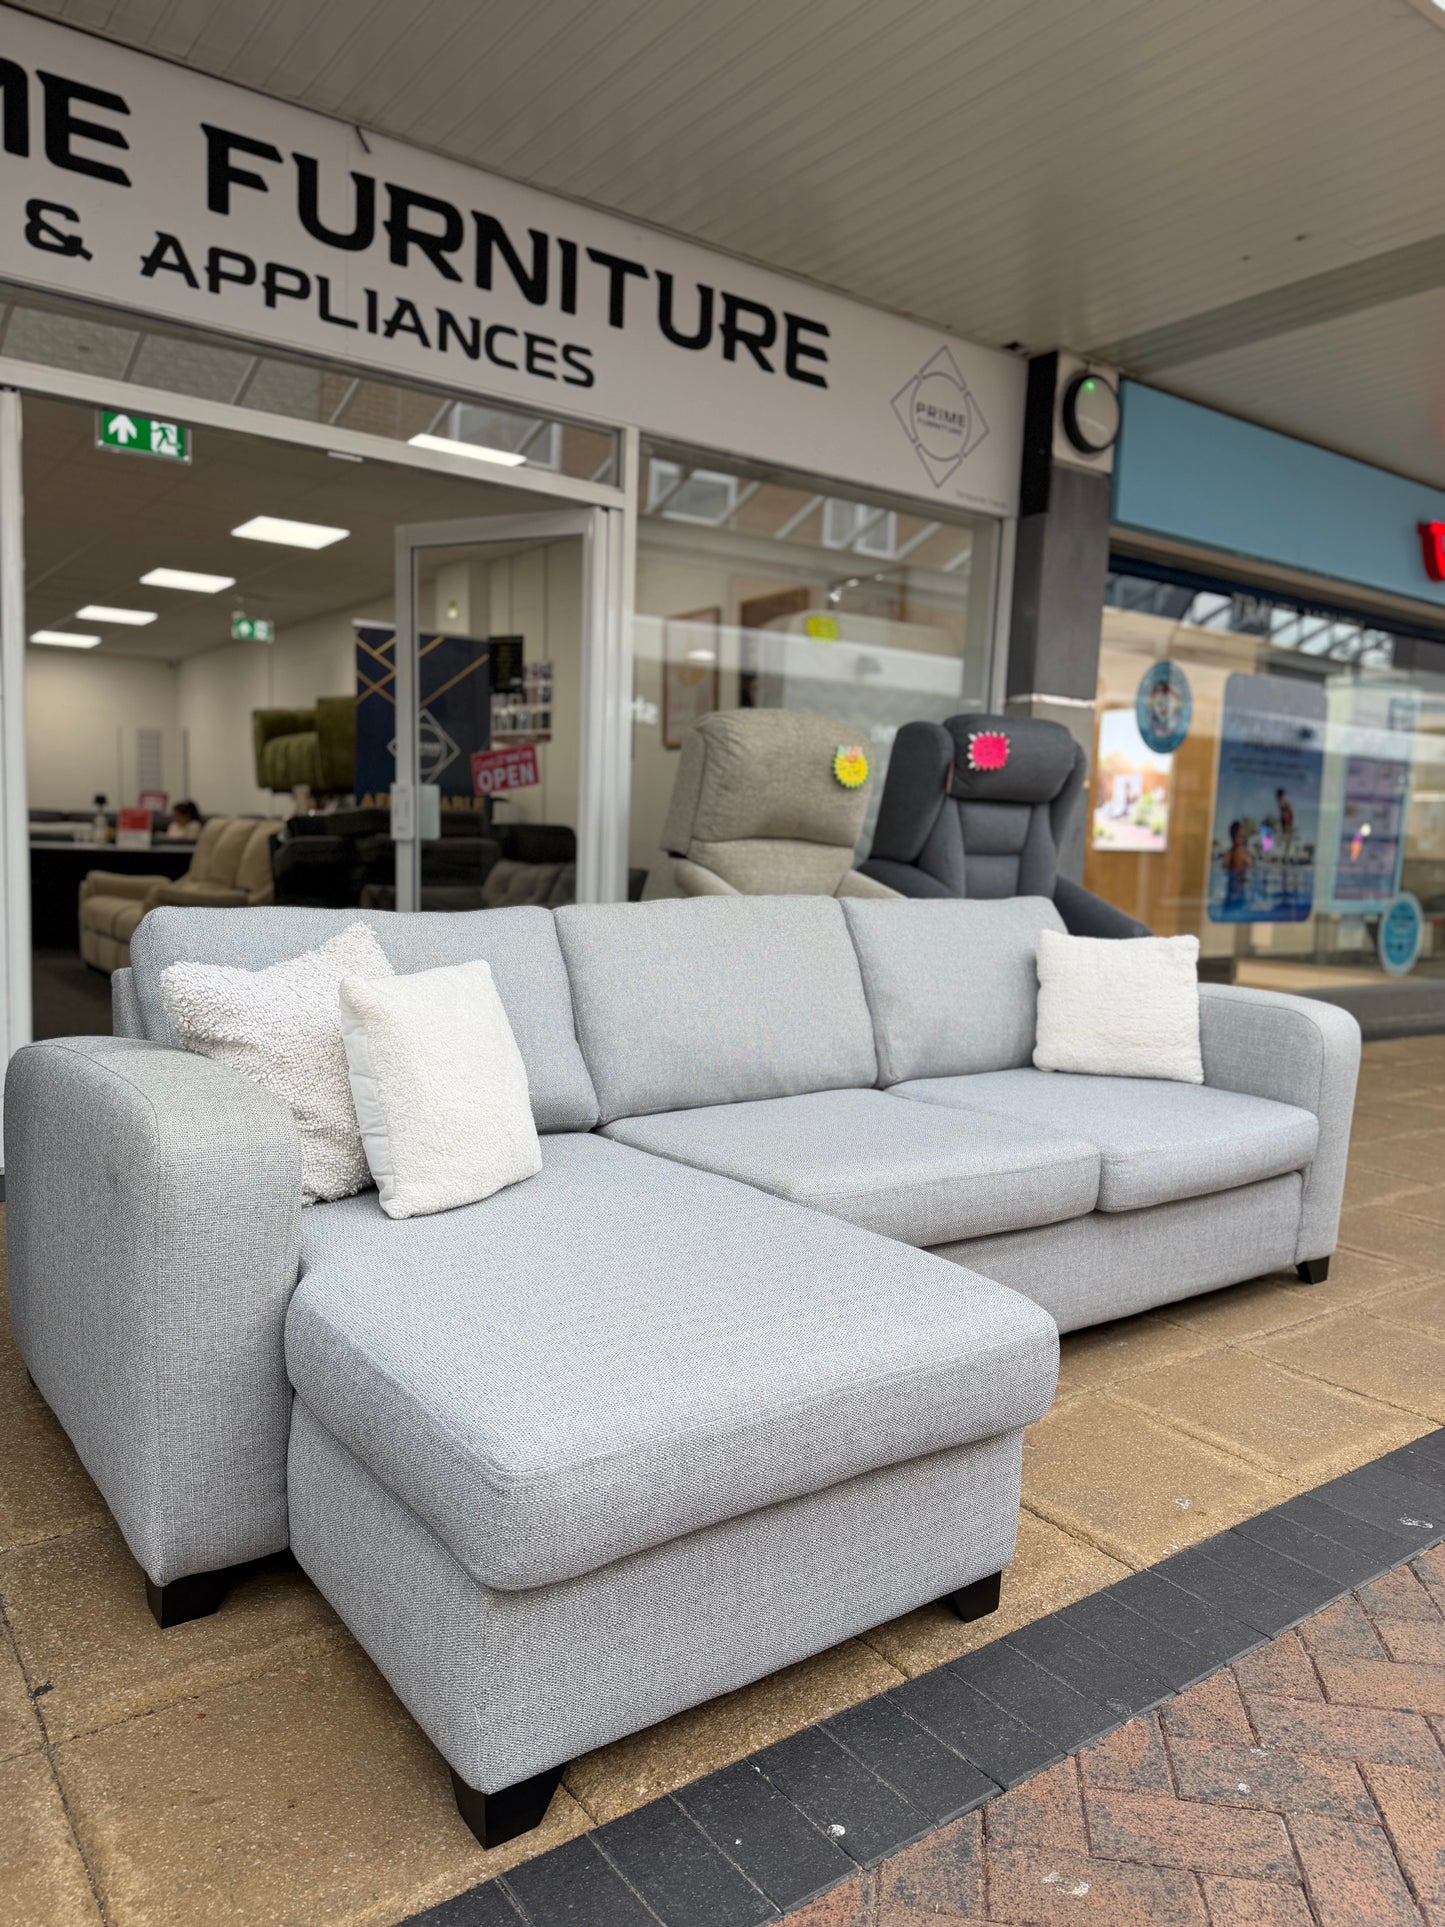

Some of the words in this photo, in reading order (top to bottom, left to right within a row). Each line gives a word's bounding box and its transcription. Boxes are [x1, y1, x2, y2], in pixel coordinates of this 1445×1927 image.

[0, 56, 132, 188] E
[201, 123, 831, 390] FURNITURE
[25, 198, 93, 262] &
[140, 231, 595, 388] APPLIANCES
[916, 402, 966, 427] PRIME
[477, 762, 534, 792] OPEN
